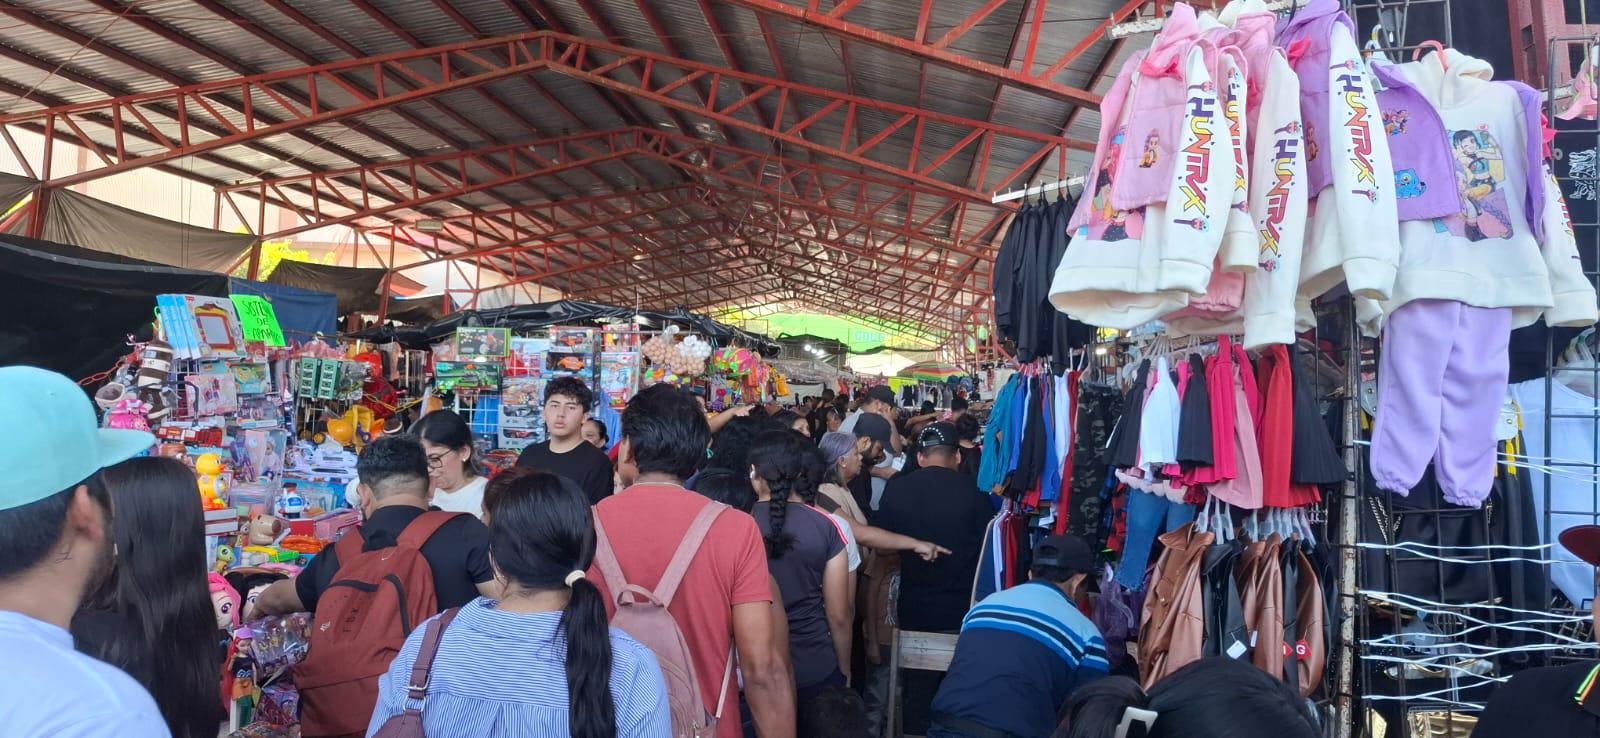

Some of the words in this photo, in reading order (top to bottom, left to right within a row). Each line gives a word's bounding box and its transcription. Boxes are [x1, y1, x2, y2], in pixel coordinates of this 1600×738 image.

[1178, 97, 1216, 215] HUNTRX
[1336, 74, 1376, 186] HUNTRX
[1259, 139, 1299, 256] HUNTRX
